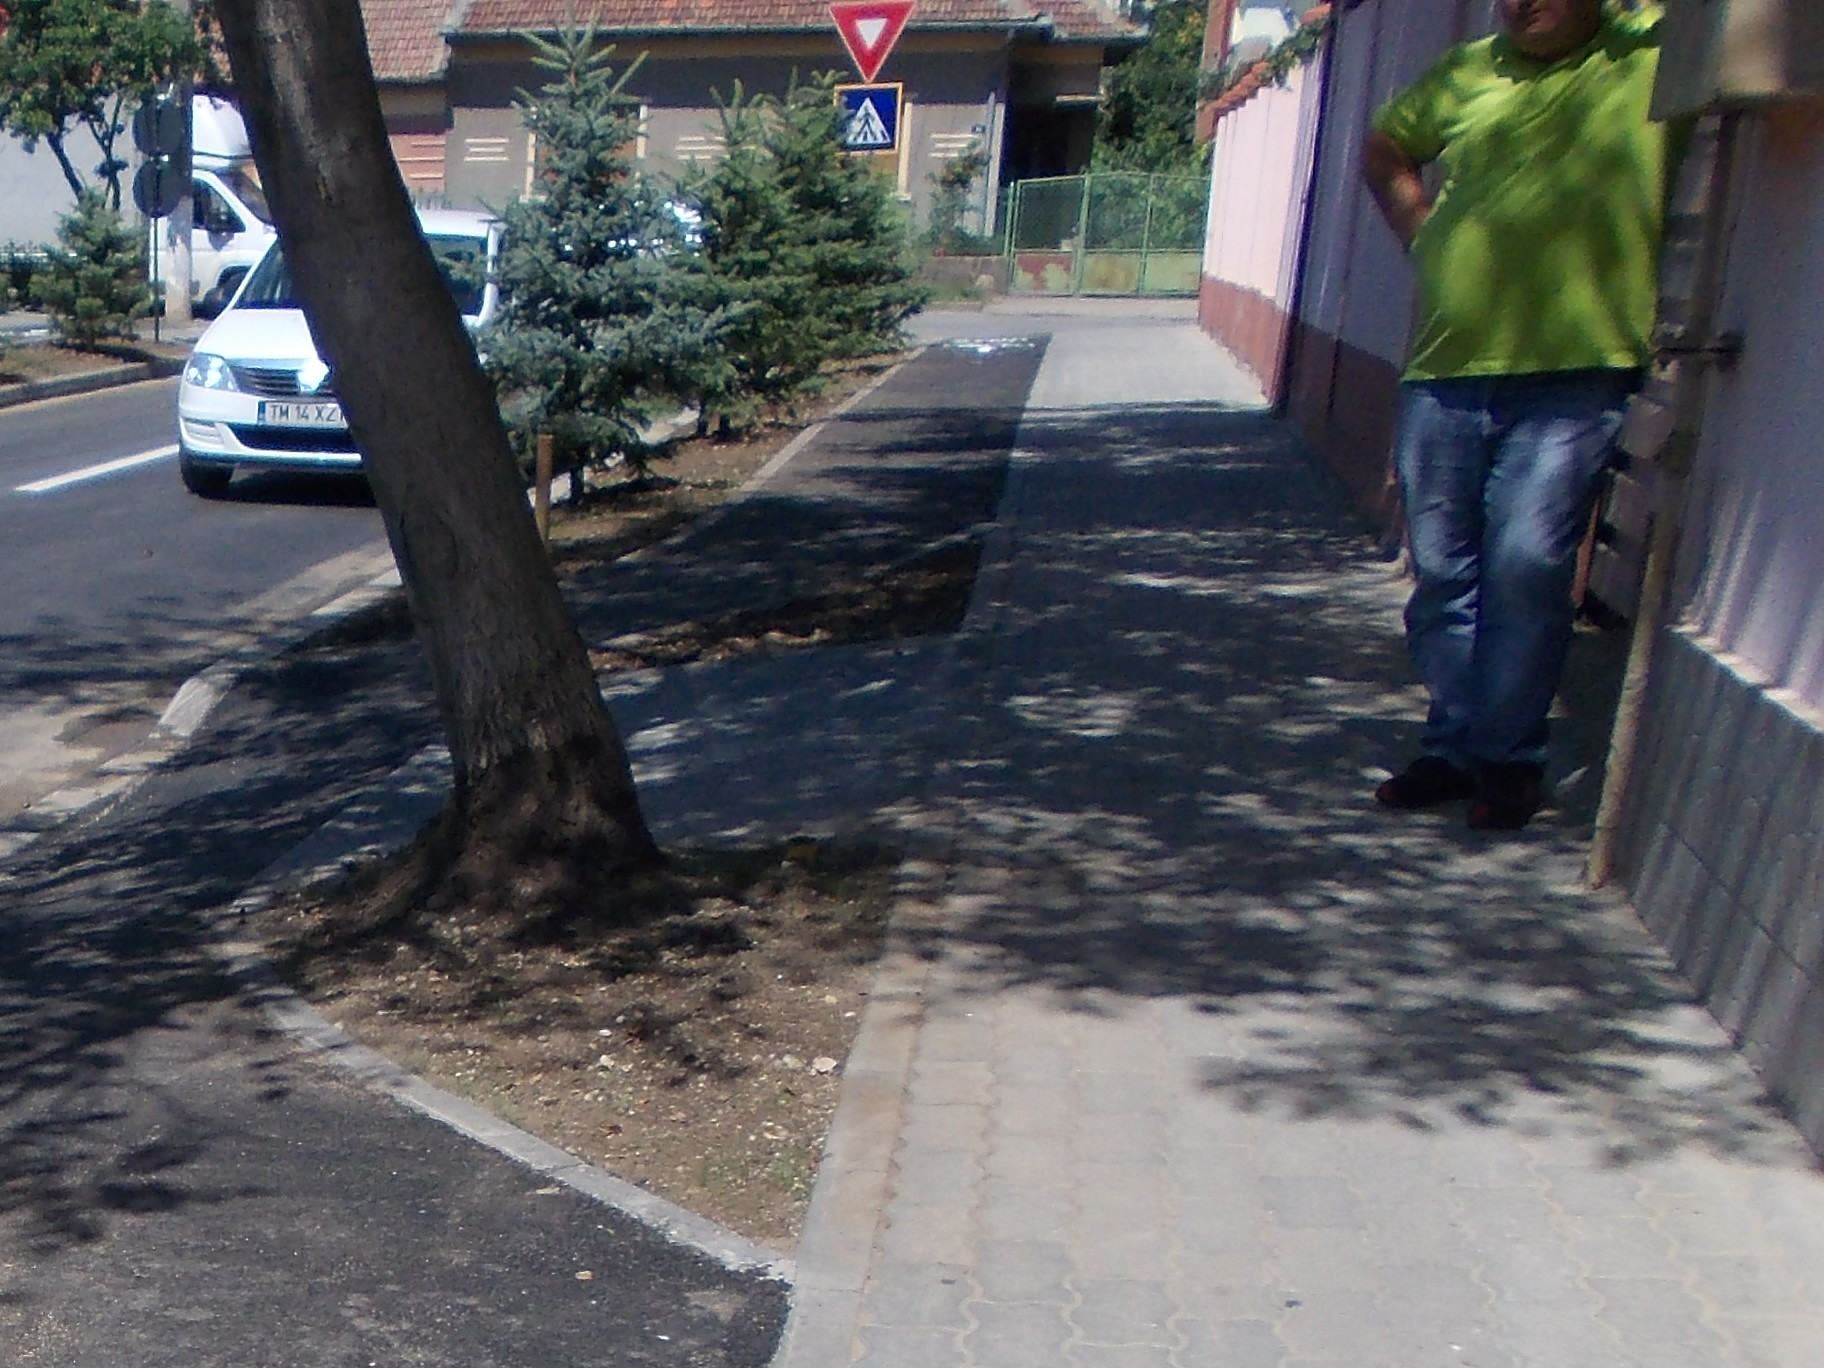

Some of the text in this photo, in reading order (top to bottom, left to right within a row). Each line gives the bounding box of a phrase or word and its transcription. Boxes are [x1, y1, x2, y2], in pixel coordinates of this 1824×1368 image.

[270, 404, 344, 422] TM 14 XZ
